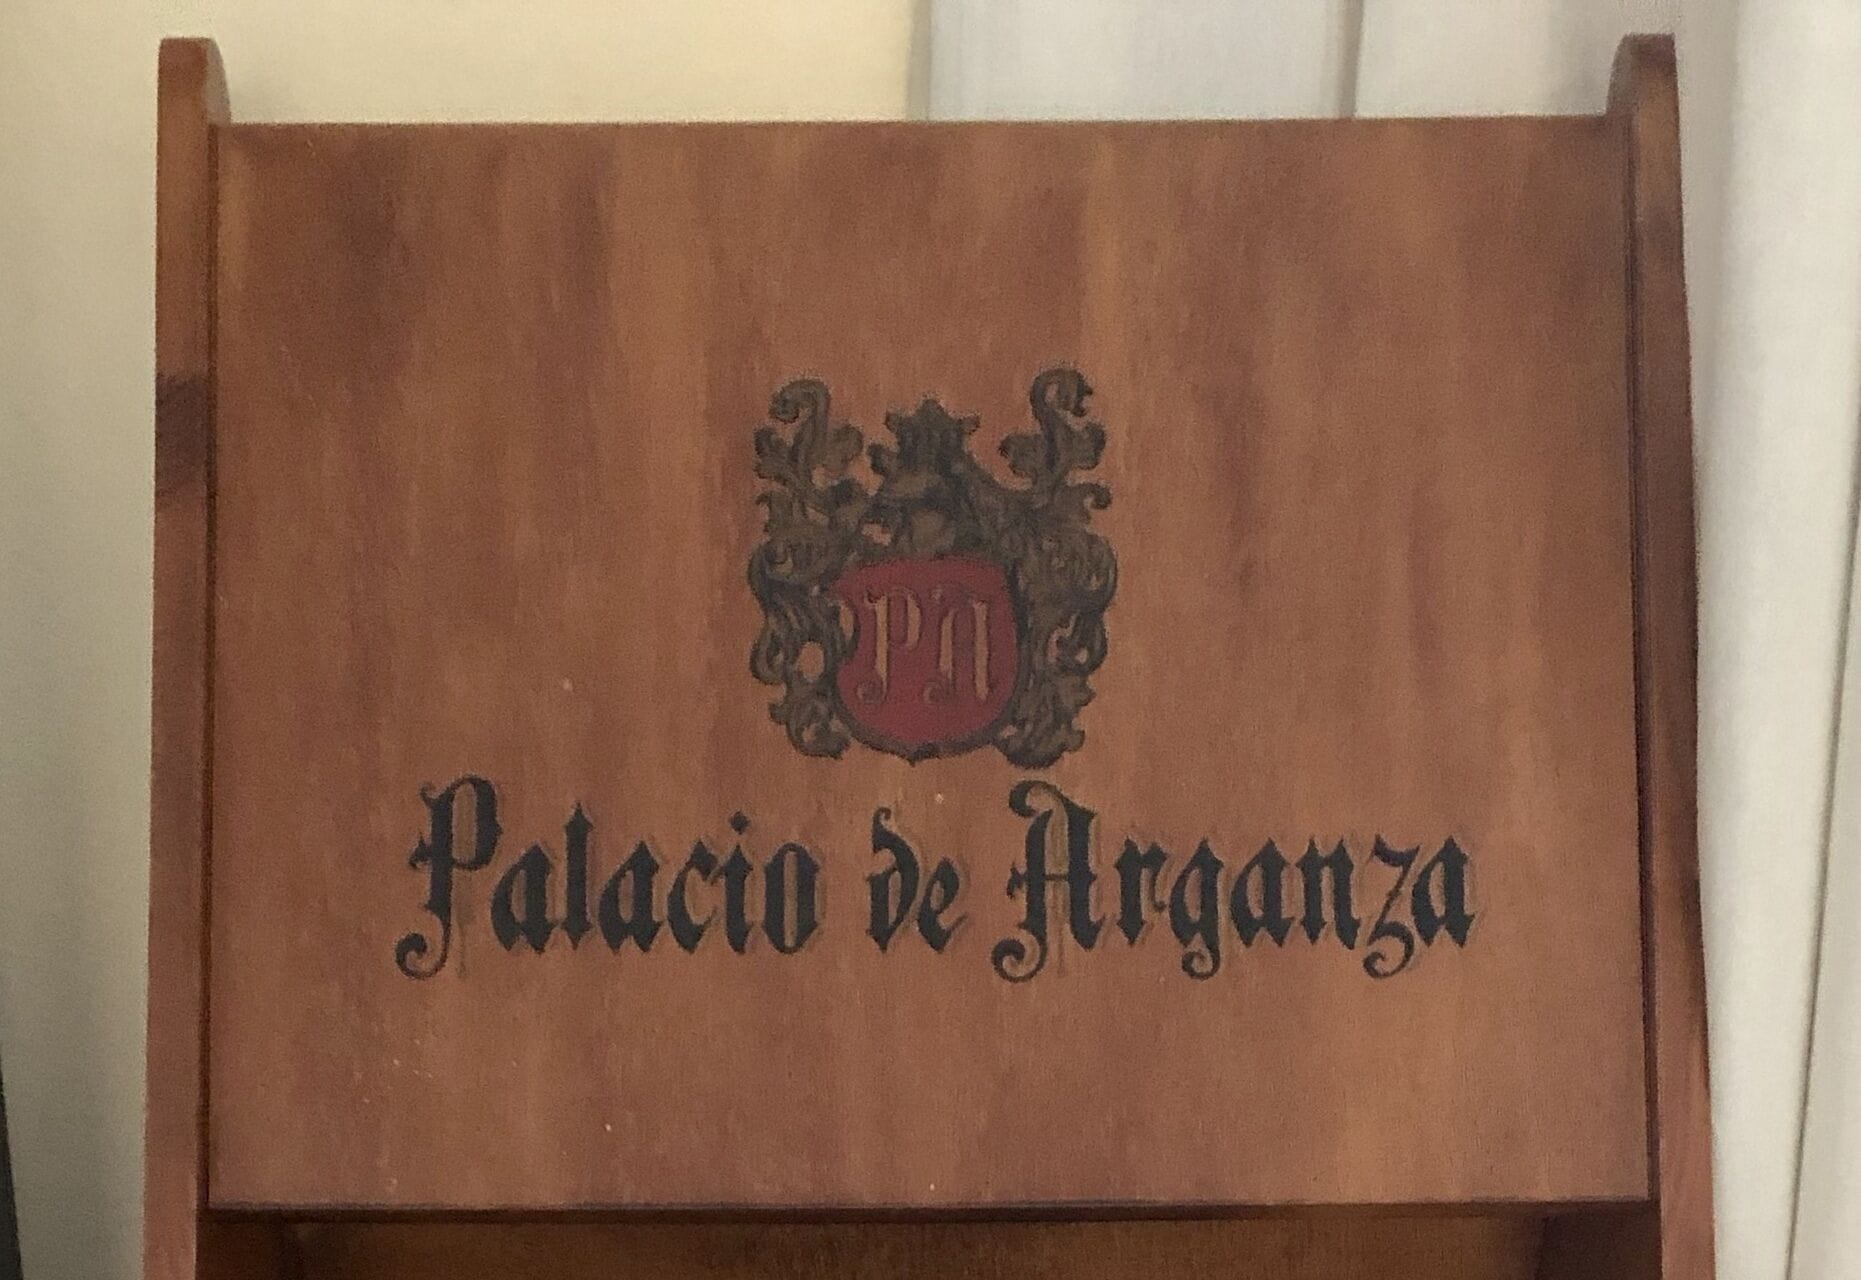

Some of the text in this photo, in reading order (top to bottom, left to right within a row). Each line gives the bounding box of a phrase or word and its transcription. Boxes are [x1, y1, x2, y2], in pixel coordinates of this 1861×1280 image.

[395, 774, 1477, 984] Palacio de Arganza
